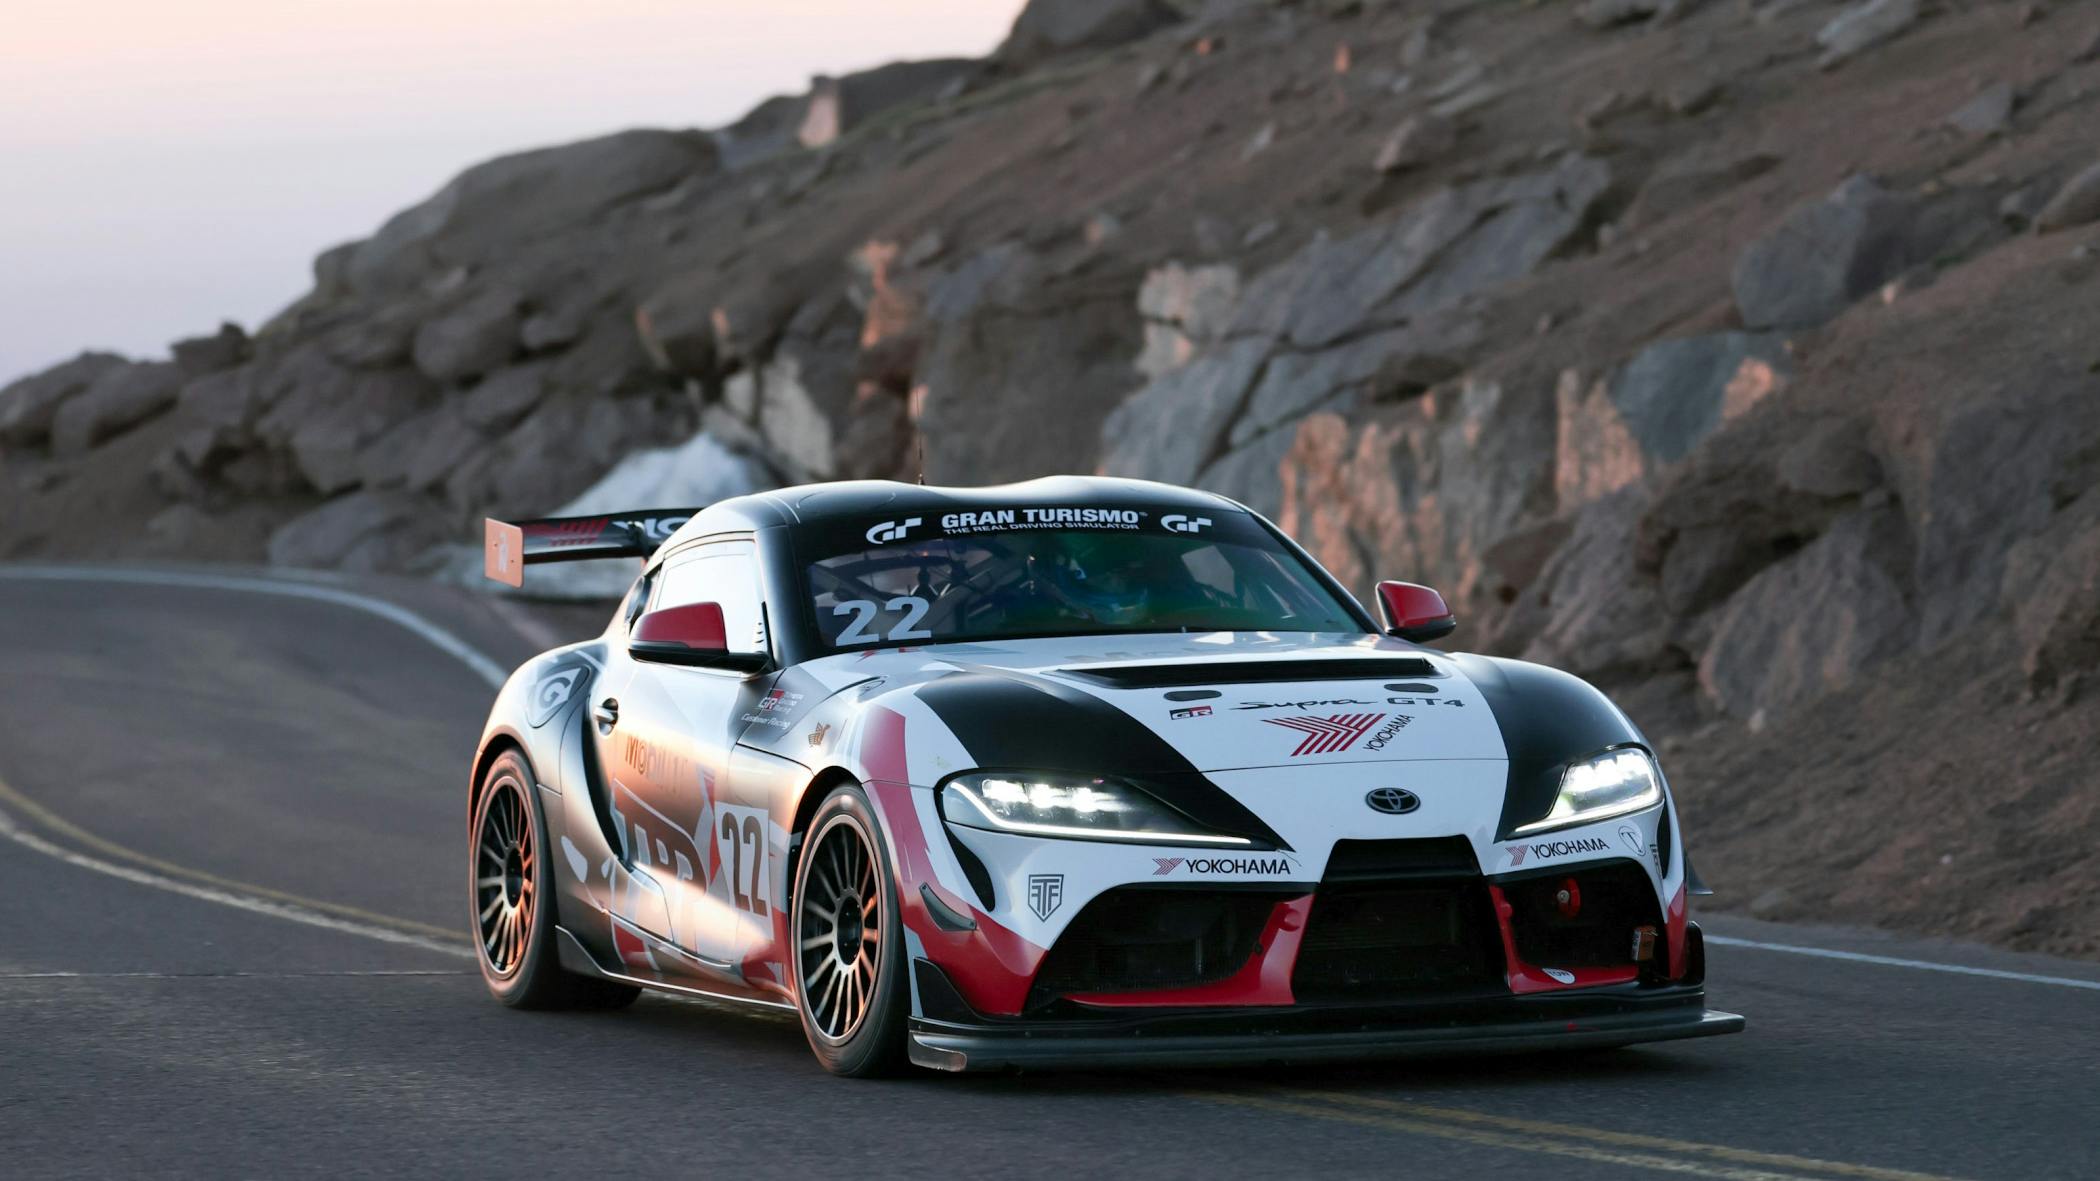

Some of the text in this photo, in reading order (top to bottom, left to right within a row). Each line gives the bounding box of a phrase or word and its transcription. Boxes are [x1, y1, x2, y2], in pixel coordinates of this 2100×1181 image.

[942, 510, 1015, 529] GRAN
[1010, 521, 1063, 530] DRIVING
[1065, 521, 1140, 530] SIMULATOR
[832, 596, 932, 647] 22
[1387, 697, 1465, 708] GT4
[1170, 707, 1213, 721] GR
[1363, 714, 1416, 752] YOKOHAMA
[1530, 837, 1610, 860] YOKOHAMA
[721, 811, 768, 917] 22
[1185, 859, 1291, 875] YOKOHAMA
